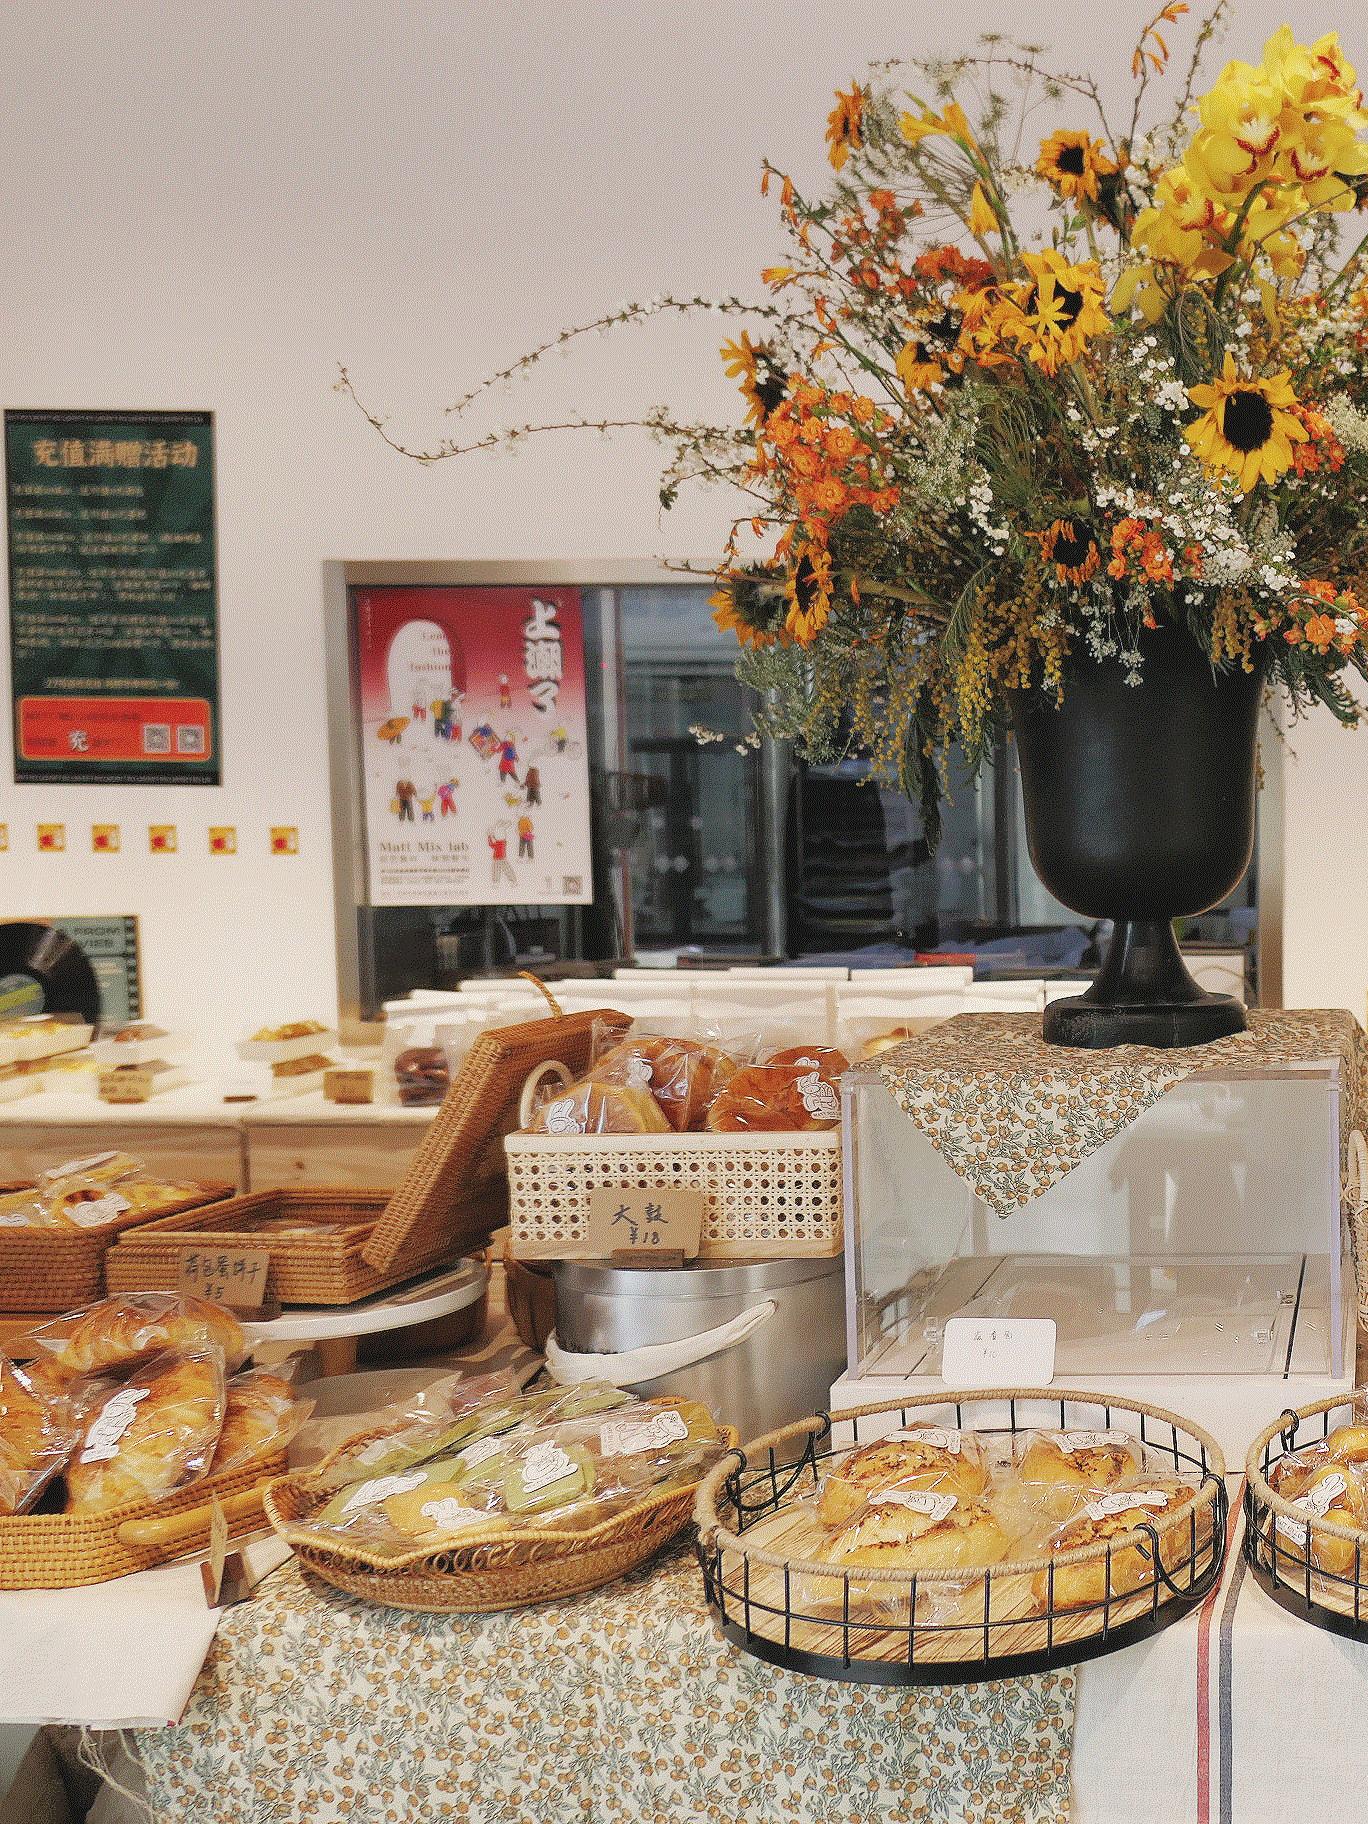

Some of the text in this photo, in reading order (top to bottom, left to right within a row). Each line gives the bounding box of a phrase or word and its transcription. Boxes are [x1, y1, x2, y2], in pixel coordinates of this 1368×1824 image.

[32, 439, 200, 469] 充值满赠活动
[611, 1202, 669, 1226] 大鼓
[629, 1226, 660, 1245] ¥18
